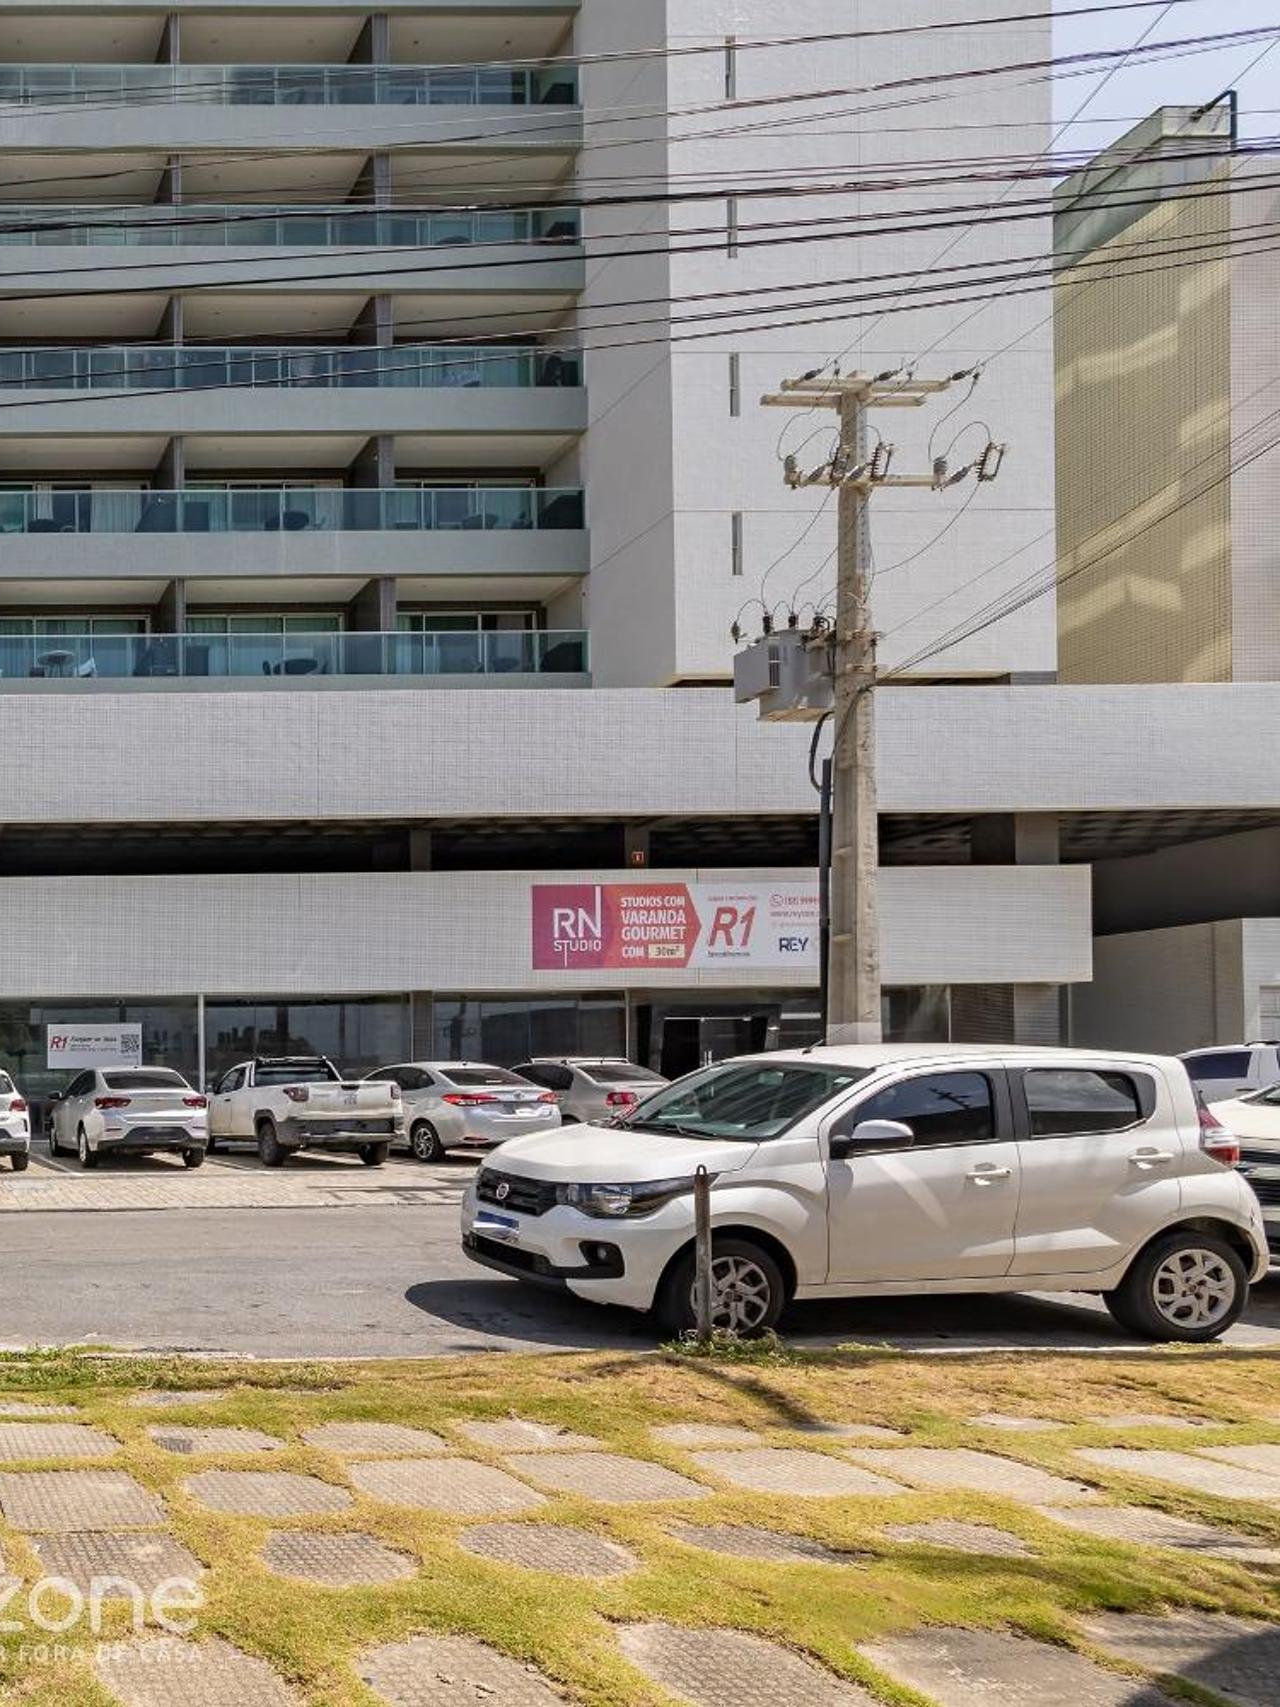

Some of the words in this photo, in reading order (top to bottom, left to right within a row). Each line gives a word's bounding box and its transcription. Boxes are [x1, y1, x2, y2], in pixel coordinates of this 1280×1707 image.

[620, 896, 663, 908] STUDIOS
[664, 895, 685, 908] COM
[553, 885, 602, 938] RN
[620, 909, 687, 925] VARANDA
[621, 926, 687, 941] GOURMET
[708, 906, 756, 947] R1
[622, 945, 645, 958] COM
[779, 937, 809, 952] REY
[554, 940, 602, 968] STUDIO
